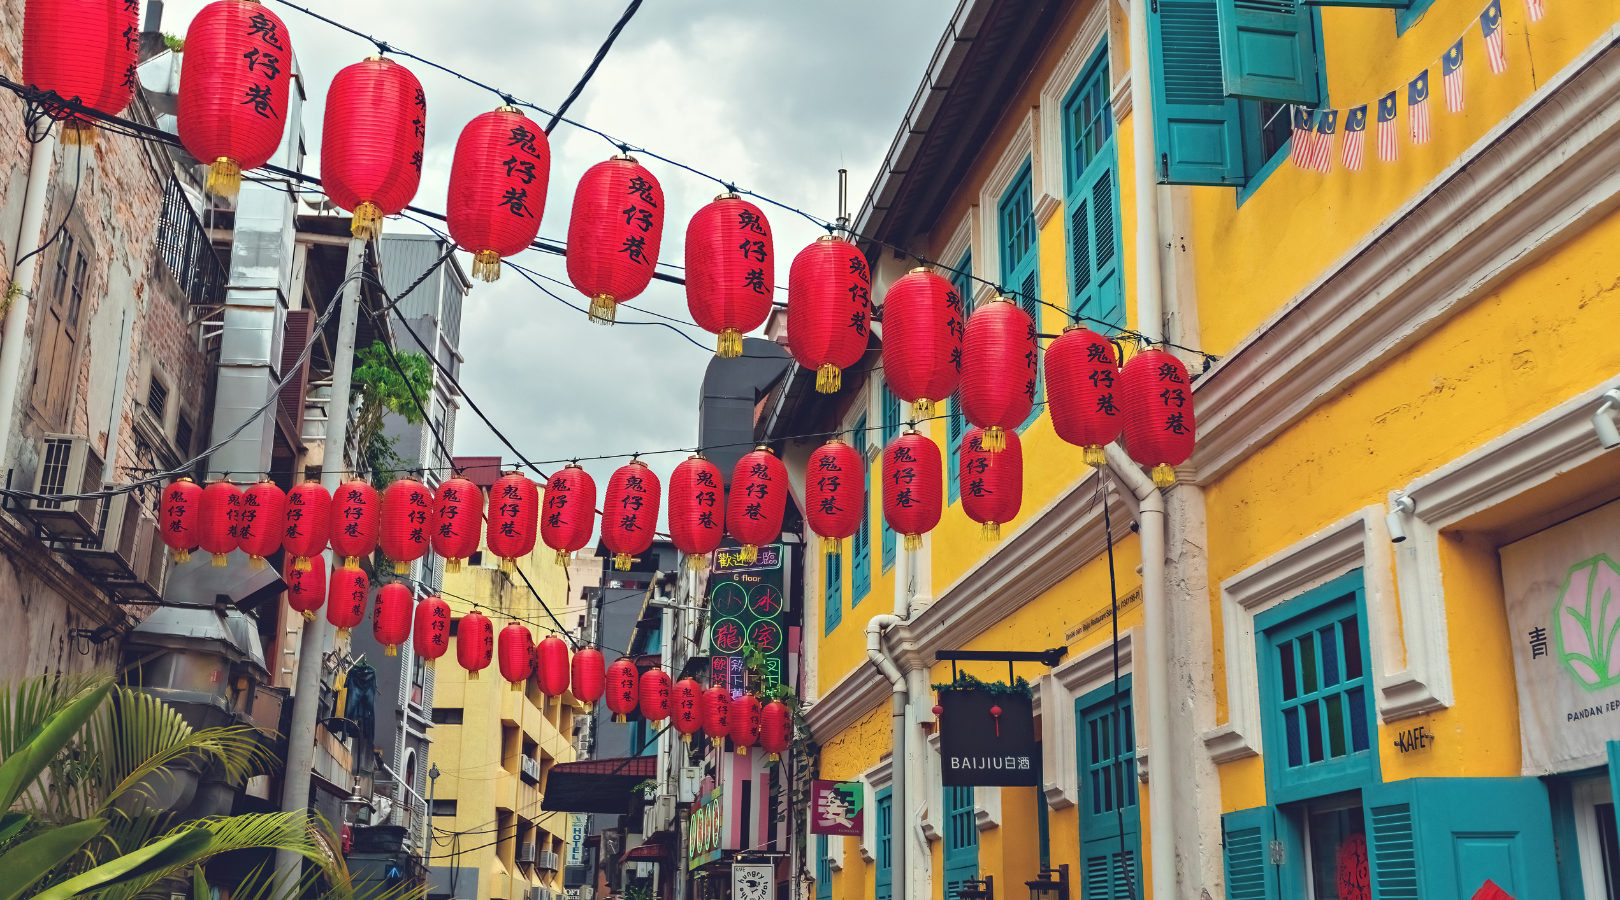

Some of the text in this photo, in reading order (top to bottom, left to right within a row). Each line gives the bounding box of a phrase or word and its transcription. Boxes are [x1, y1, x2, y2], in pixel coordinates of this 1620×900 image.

[240, 12, 283, 119] 鬼仔巷
[498, 125, 540, 218] 鬼仔巷
[617, 175, 657, 266] 鬼仔巷
[738, 208, 771, 295] 鬼仔巷
[847, 255, 871, 338] 鬼仔巷
[1086, 342, 1121, 416] 鬼仔巷
[1158, 363, 1191, 435] 鬼仔巷
[547, 477, 570, 528] 鬼仔巷
[696, 470, 718, 529] 鬼仔巷
[742, 463, 772, 521] 鬼仔巷
[817, 455, 844, 515] 鬼仔巷
[893, 446, 920, 508] 鬼仔巷
[168, 490, 188, 533] 鬼仔巷
[238, 493, 261, 539] 鬼仔巷
[285, 492, 306, 539] 鬼仔巷
[343, 489, 367, 538] 鬼仔巷
[408, 491, 428, 544] 鬼仔巷
[438, 488, 461, 538] 鬼仔巷
[500, 484, 521, 538] 鬼仔巷
[620, 475, 646, 532] 鬼仔巷
[352, 576, 367, 616] 鬼仔巷
[742, 574, 761, 582] floor
[431, 606, 447, 646] 鬼仔巷
[1528, 626, 1548, 660] 青
[622, 667, 634, 702] 鬼仔巷
[1567, 705, 1603, 722] PANDAN
[1398, 726, 1426, 753] KAFE
[572, 827, 581, 860] HOTEL
[737, 870, 765, 884] hungry
